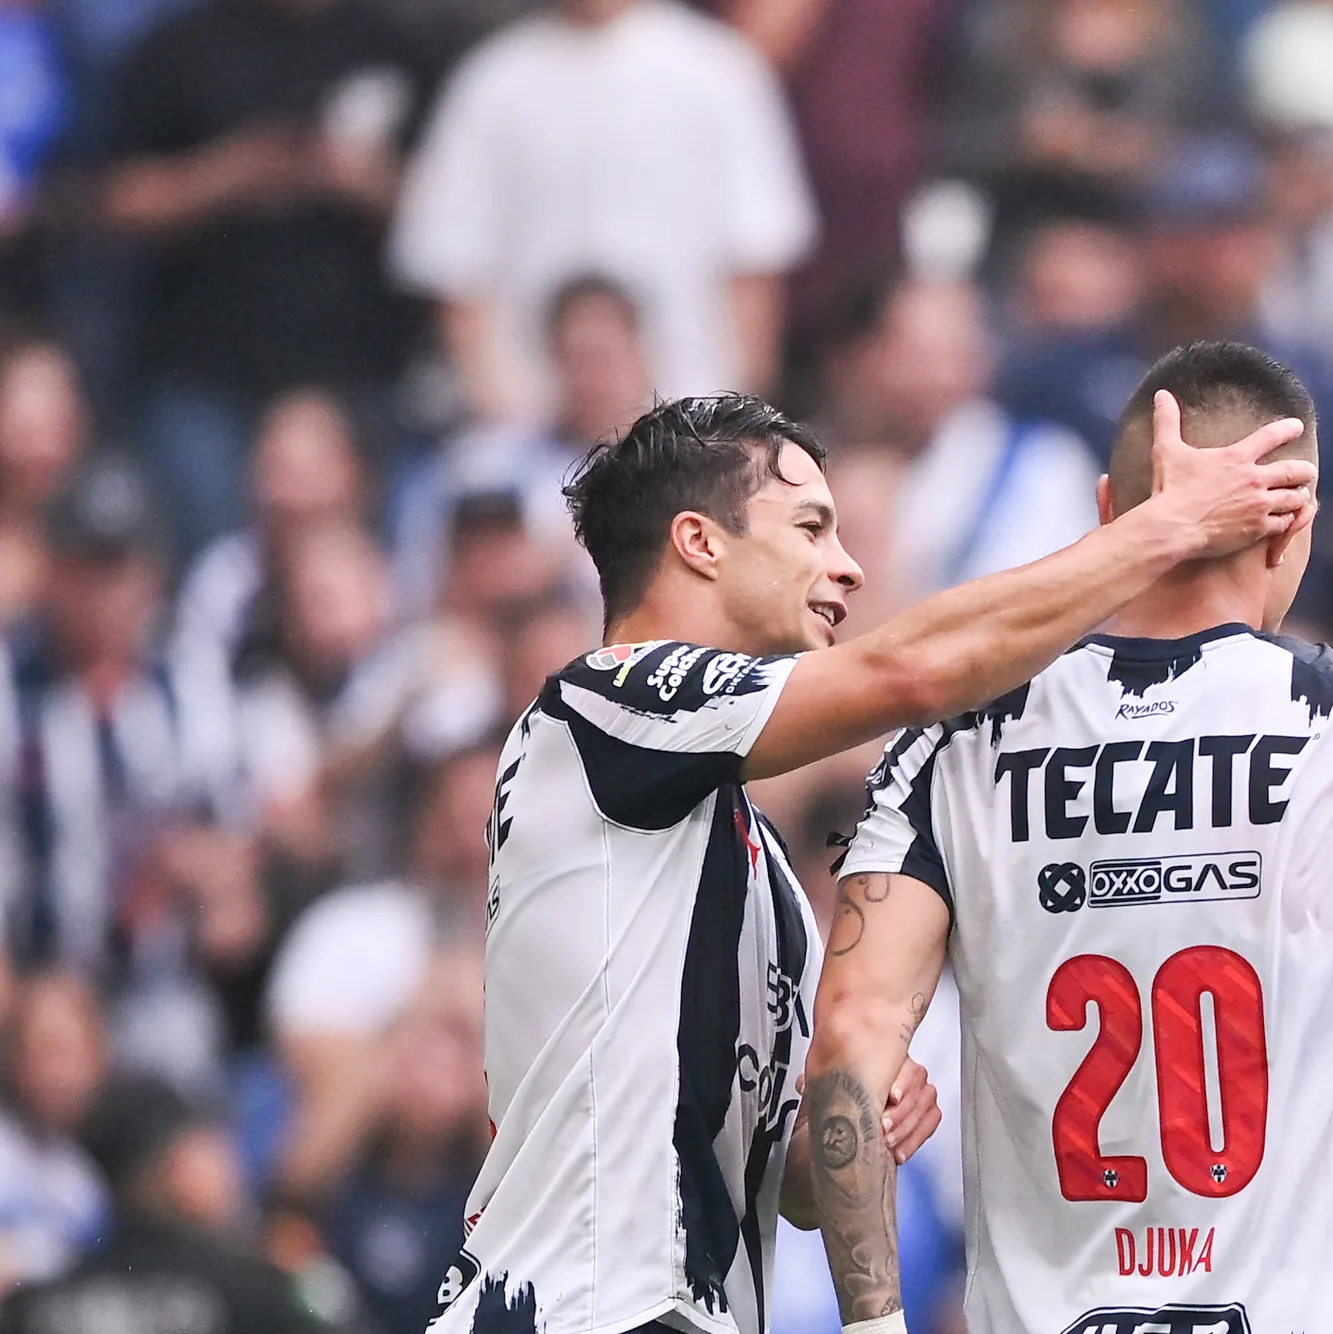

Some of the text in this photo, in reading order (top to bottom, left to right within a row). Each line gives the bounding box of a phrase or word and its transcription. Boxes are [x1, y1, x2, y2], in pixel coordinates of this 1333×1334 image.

[994, 733, 1312, 843] TECATE
[1045, 944, 1269, 1203] 20
[1114, 1227, 1216, 1278] DJUKA
